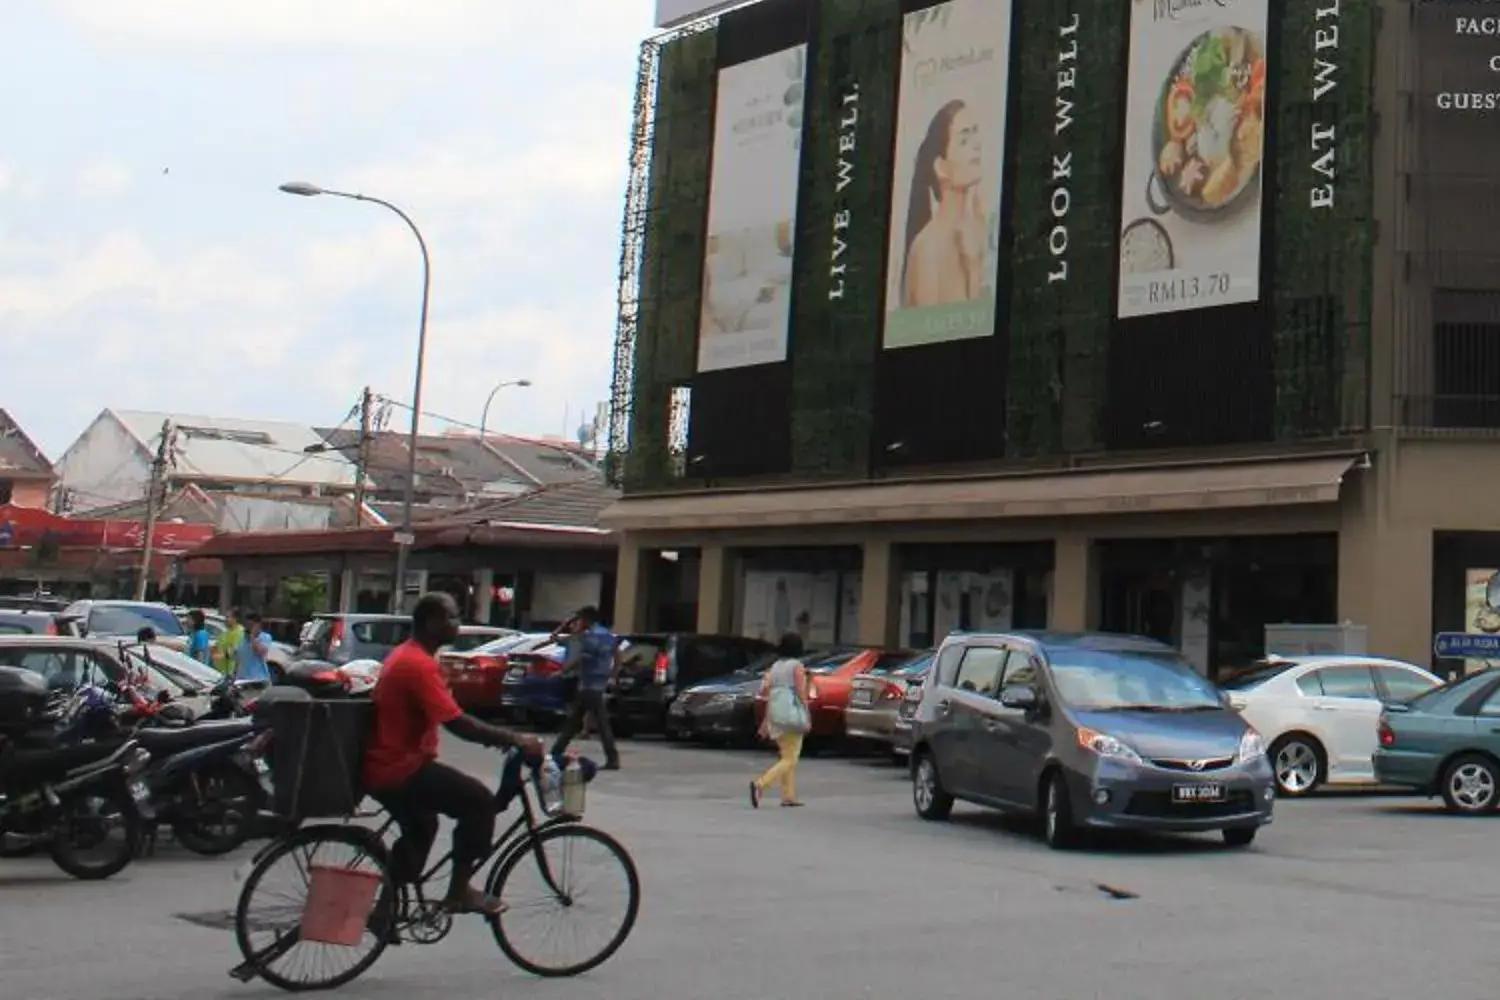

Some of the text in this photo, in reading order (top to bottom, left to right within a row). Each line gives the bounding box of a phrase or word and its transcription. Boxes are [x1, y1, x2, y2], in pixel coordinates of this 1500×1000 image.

[827, 81, 861, 301] LIVE WELL
[1047, 12, 1081, 283] LOOK WELL
[1309, 122, 1336, 210] EAT
